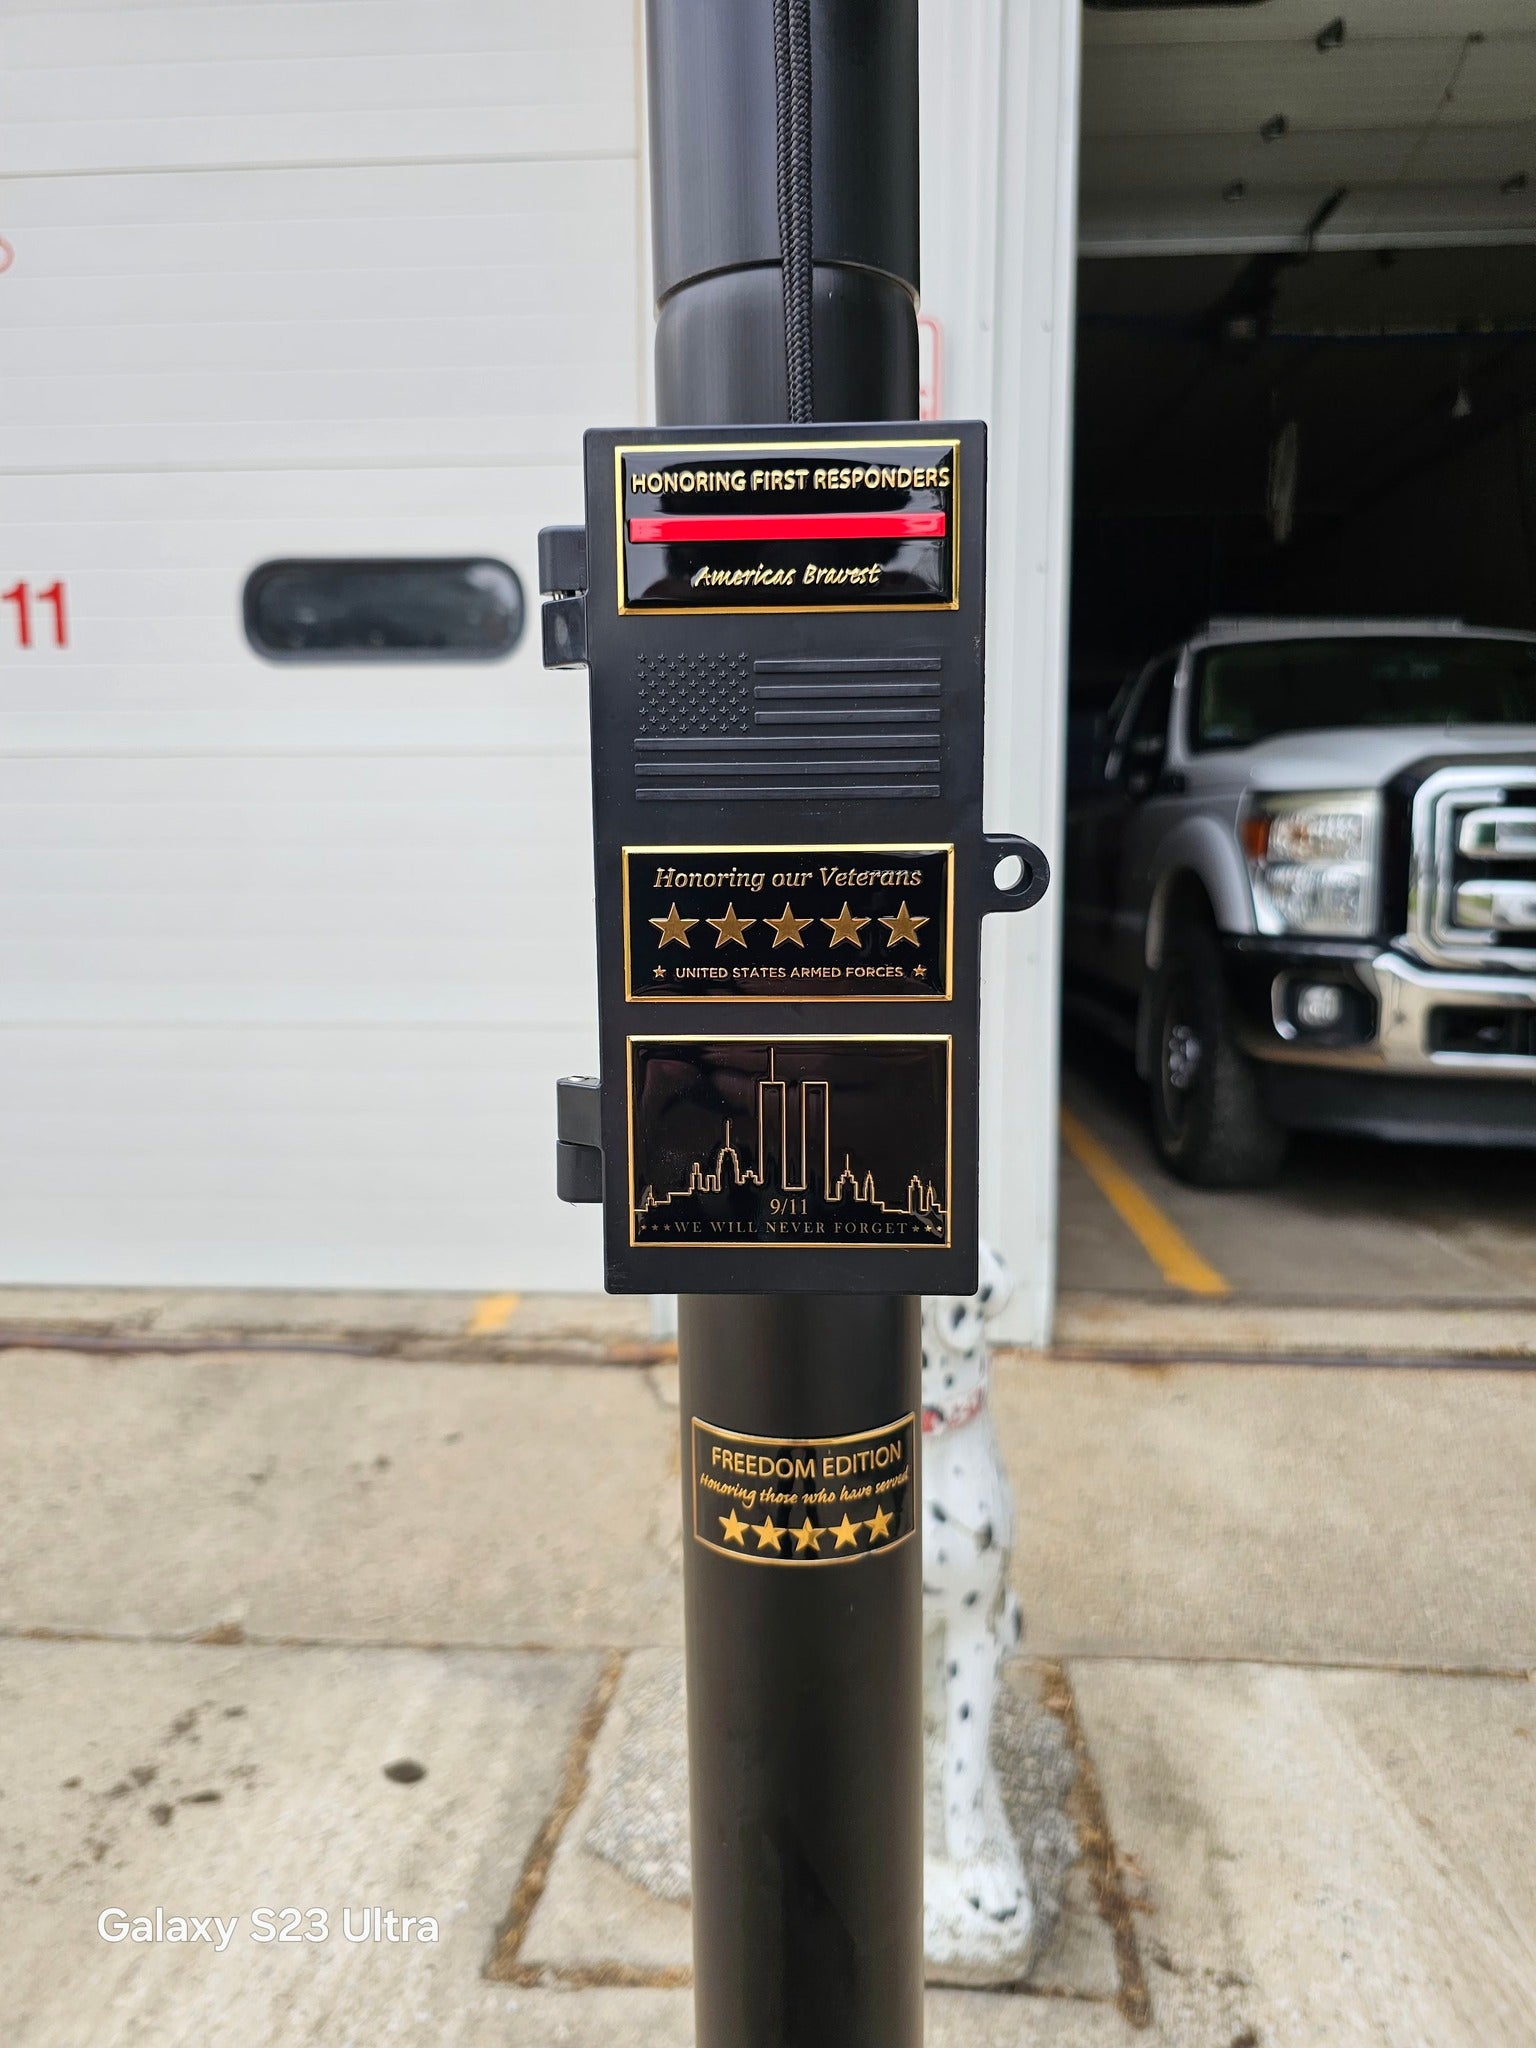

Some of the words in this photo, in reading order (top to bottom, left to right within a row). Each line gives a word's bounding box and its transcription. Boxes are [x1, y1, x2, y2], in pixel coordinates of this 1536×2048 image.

[632, 470, 746, 493] HONORING
[753, 469, 809, 491] FIRST
[814, 468, 950, 490] RESPONDERS
[694, 564, 795, 586] Americas
[803, 563, 881, 586] Bravest
[0, 581, 67, 647] 11
[654, 867, 765, 891] Honoring
[773, 872, 813, 887] our
[820, 867, 922, 887] Veterans
[676, 967, 728, 979] UNITED
[732, 967, 787, 979] STATES
[790, 967, 841, 979] ARMED
[846, 967, 904, 978] FORCES
[769, 1198, 808, 1215] 9/11
[673, 1222, 702, 1233] WE
[710, 1222, 758, 1233] WILL
[766, 1222, 825, 1234] NEVER
[834, 1222, 908, 1234] FORGET
[712, 1447, 815, 1478] FREEDOM
[823, 1441, 902, 1476] EDITION
[700, 1472, 757, 1509] Honoring
[760, 1487, 798, 1504] those
[802, 1488, 835, 1504] who
[840, 1484, 872, 1500] have
[876, 1466, 909, 1493] served
